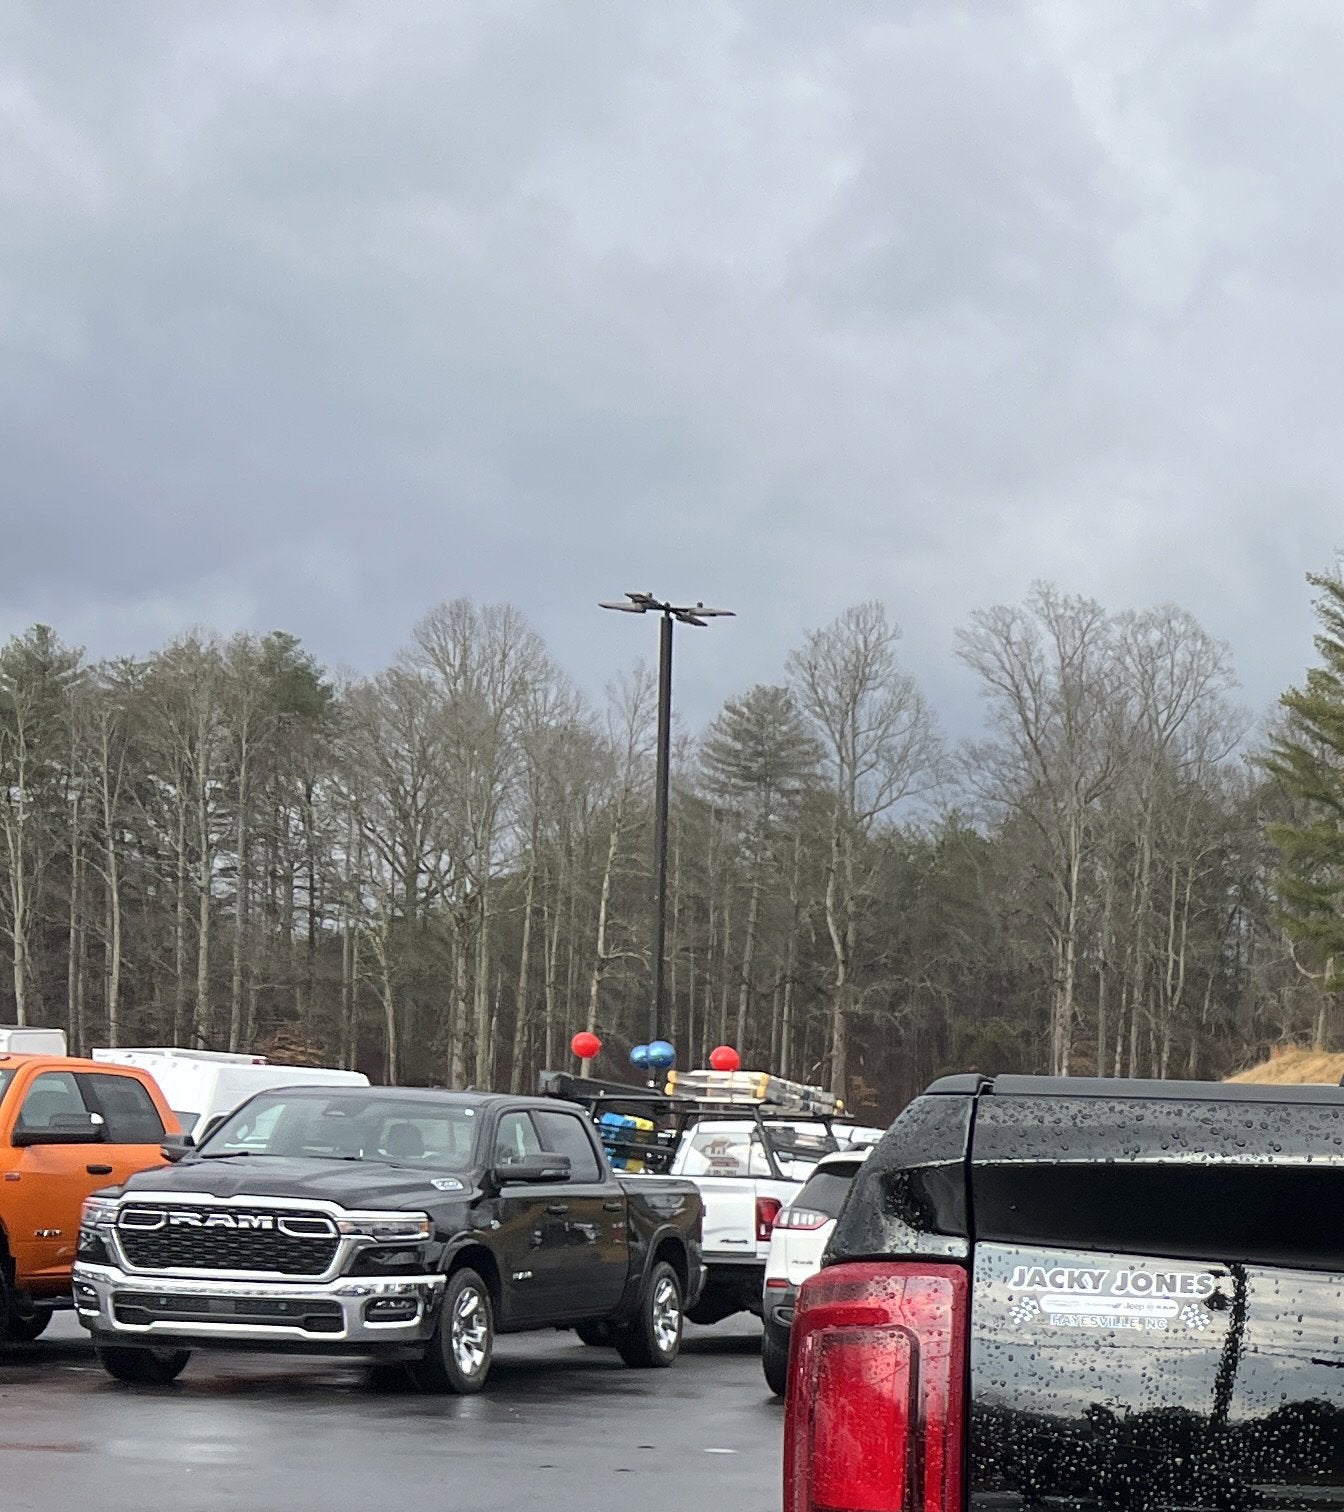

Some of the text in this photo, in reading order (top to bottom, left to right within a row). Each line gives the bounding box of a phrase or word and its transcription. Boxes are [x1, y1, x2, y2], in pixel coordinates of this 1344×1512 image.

[168, 1211, 274, 1229] RAM
[1008, 1266, 1216, 1298] JACKY JONES
[1124, 1302, 1145, 1311] Jeep
[1145, 1317, 1169, 1330] NC
